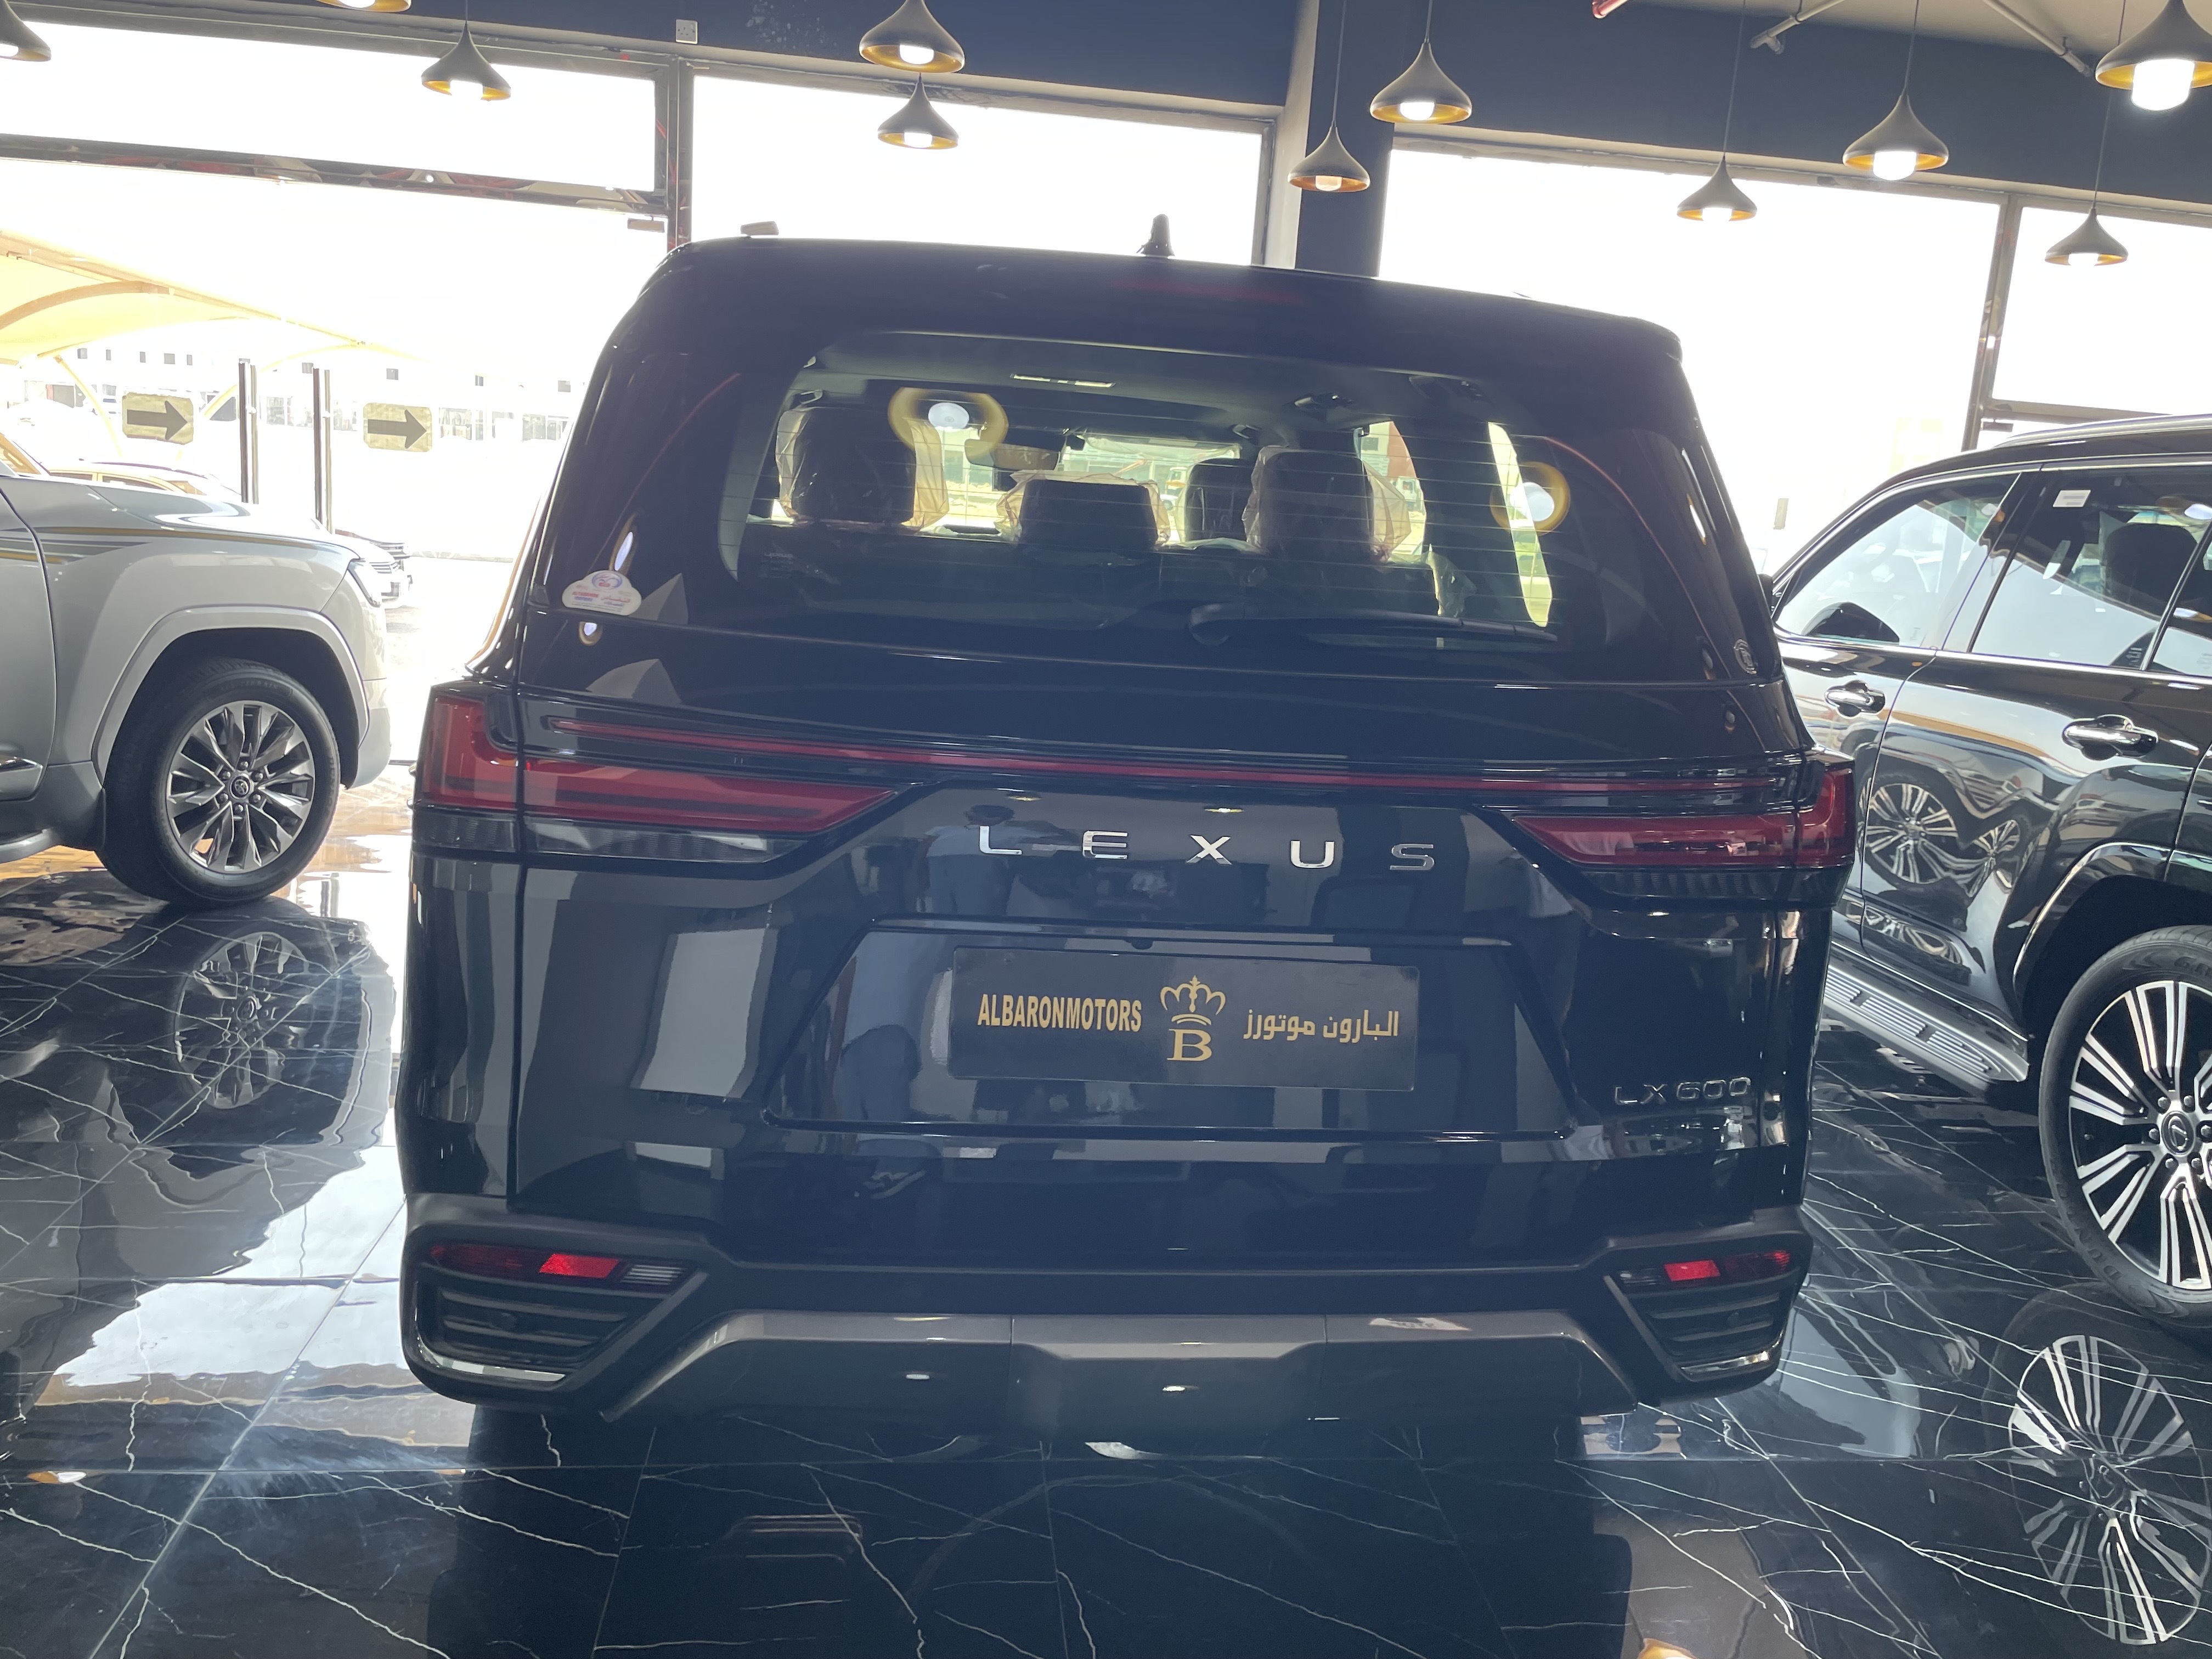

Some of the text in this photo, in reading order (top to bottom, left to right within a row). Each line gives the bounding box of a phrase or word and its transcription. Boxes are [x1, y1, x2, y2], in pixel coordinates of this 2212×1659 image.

[979, 825, 1435, 871] LEXUS
[977, 994, 1142, 1032] ALBARONMOTORS
[1243, 1009, 1399, 1043] البارون موتورز
[1167, 1028, 1212, 1062] B
